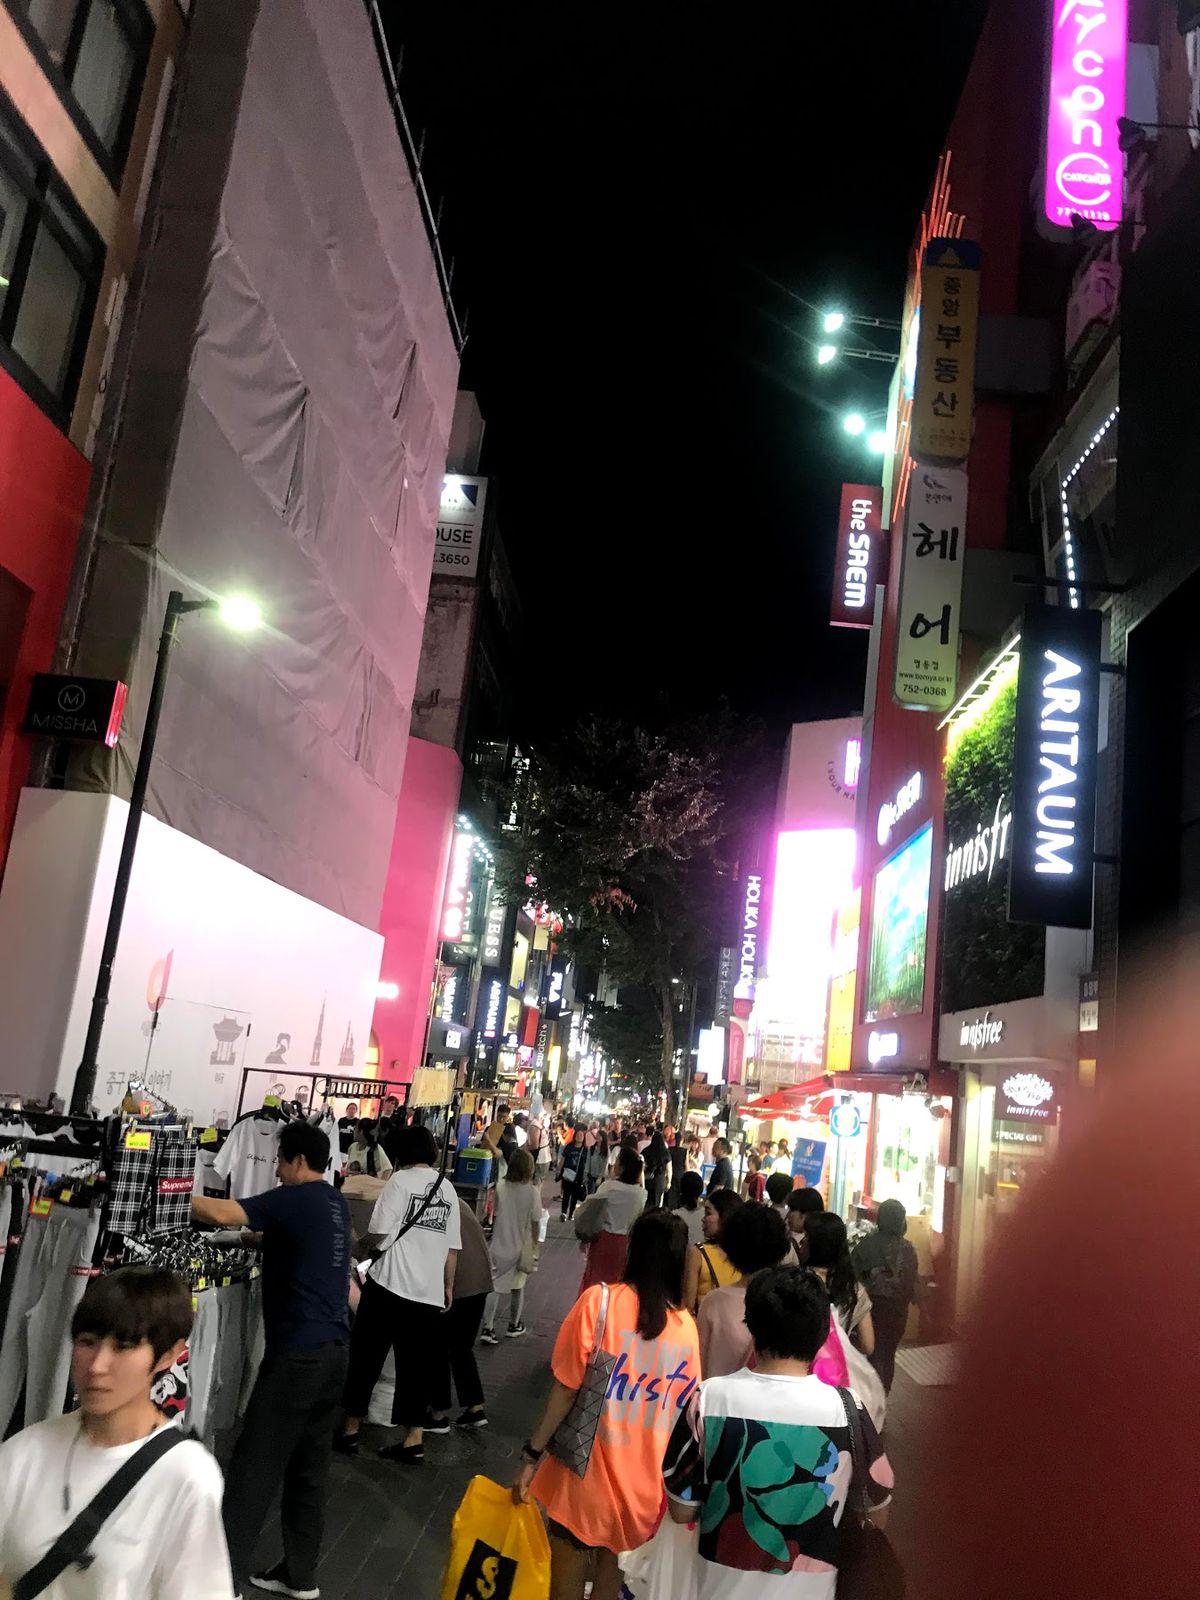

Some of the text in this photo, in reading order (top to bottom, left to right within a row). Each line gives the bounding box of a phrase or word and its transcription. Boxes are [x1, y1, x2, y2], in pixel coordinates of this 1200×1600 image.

[907, 522, 960, 646] 헤어
[903, 683, 947, 697] 752-0368
[32, 712, 98, 733] MISSHA
[1034, 648, 1082, 874] ARITAUM
[960, 1011, 1004, 1049] innisfree
